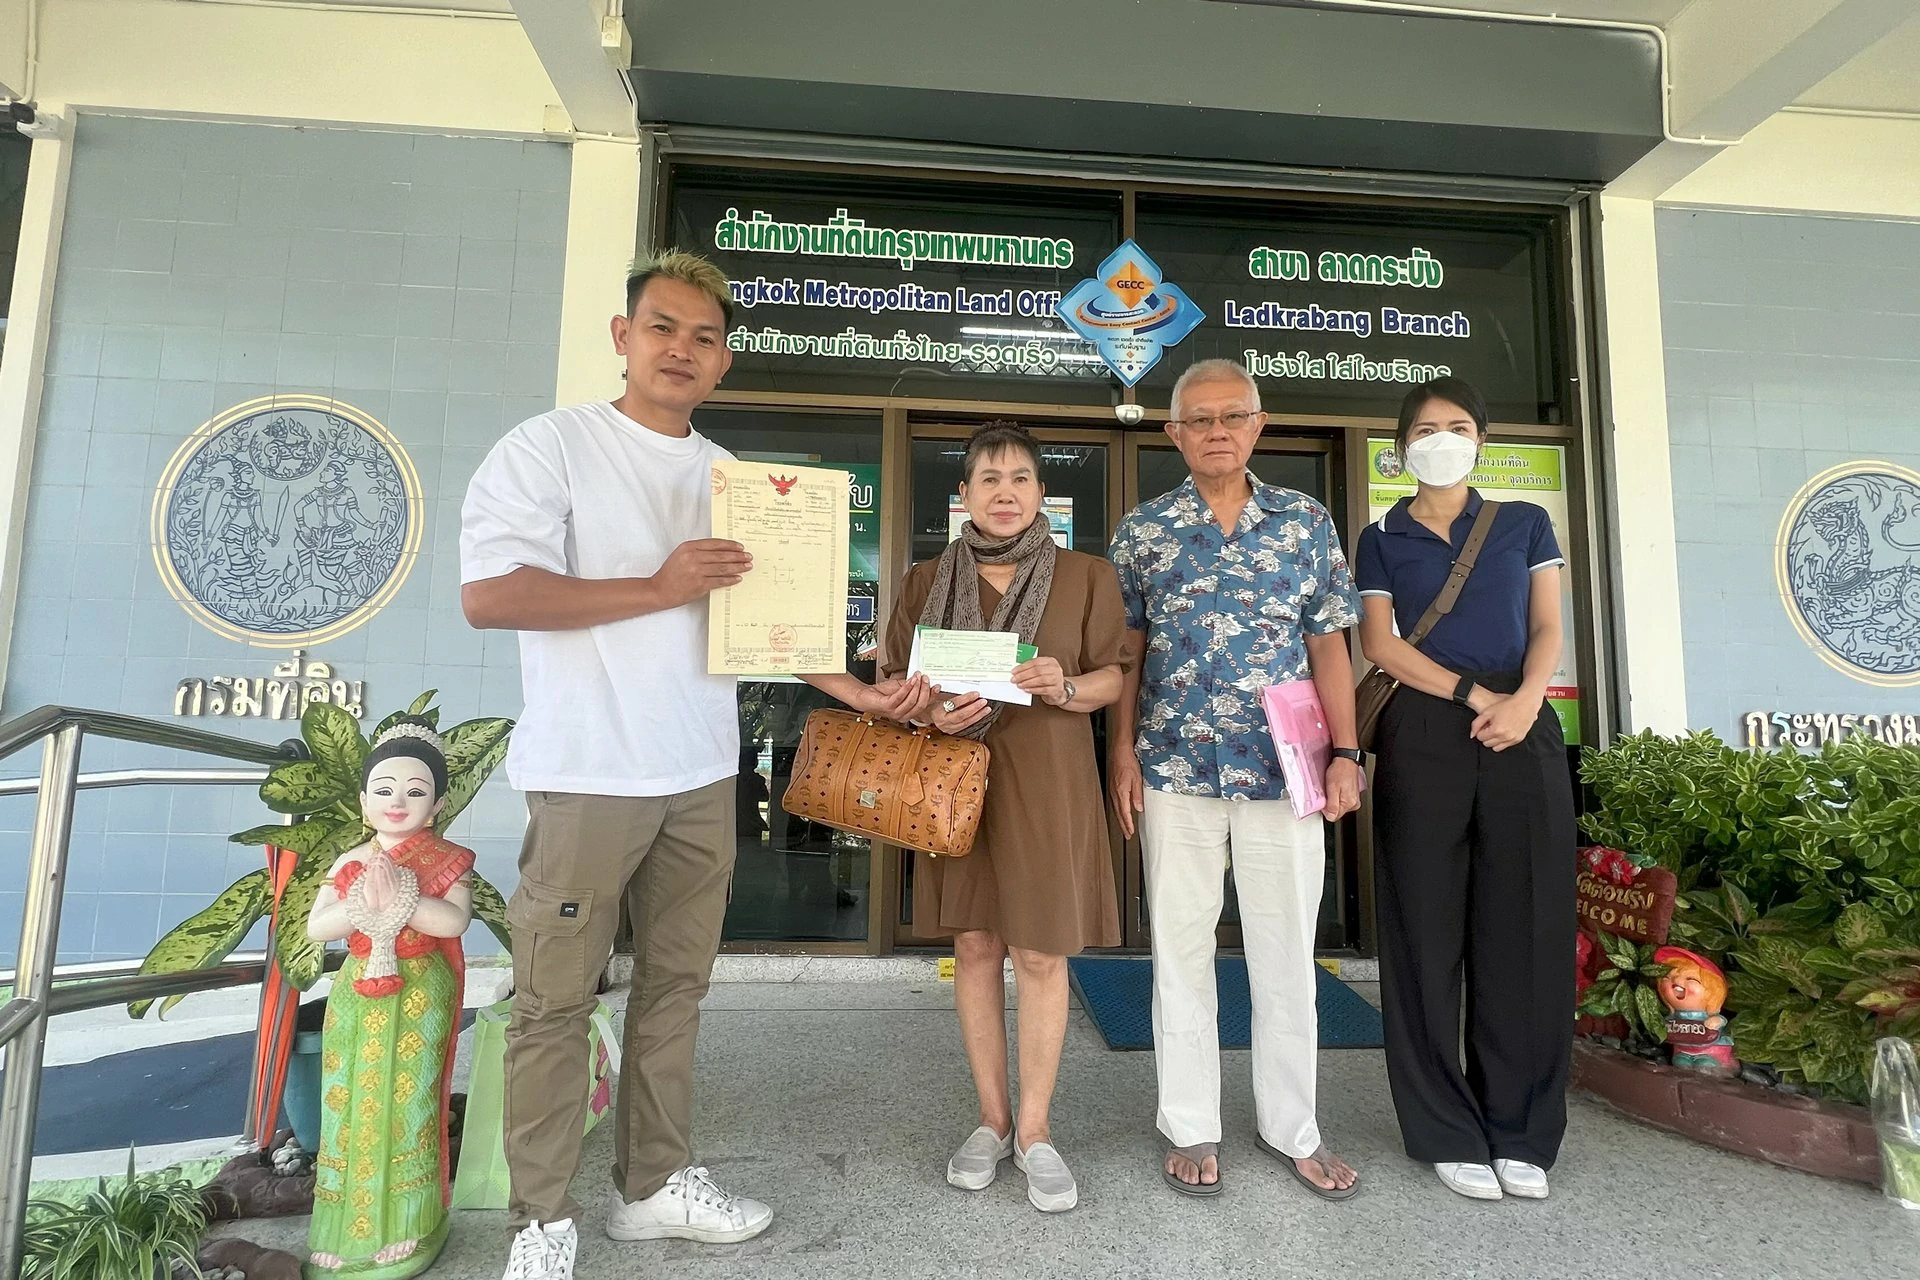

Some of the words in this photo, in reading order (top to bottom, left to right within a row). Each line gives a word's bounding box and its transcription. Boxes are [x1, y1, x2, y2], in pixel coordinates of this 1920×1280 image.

[716, 208, 1073, 270] สำนักงานที่ดินกรุงเทพมหานคร
[1117, 280, 1144, 289] GECC
[1249, 247, 1309, 280] สาขา
[1318, 248, 1443, 288] ลาดกระบัง
[729, 277, 799, 308] ngkok
[804, 279, 950, 314] Metropolitan
[956, 287, 1011, 315] Land
[1017, 290, 1061, 317] Offi
[1225, 300, 1371, 338] Ladkrabang
[1382, 307, 1470, 338] Branch
[727, 326, 961, 363] สำนักงานที่ดินทั่วไทย
[970, 340, 1058, 367] รวดเร็ว
[174, 650, 364, 719] กรมที่ดิน
